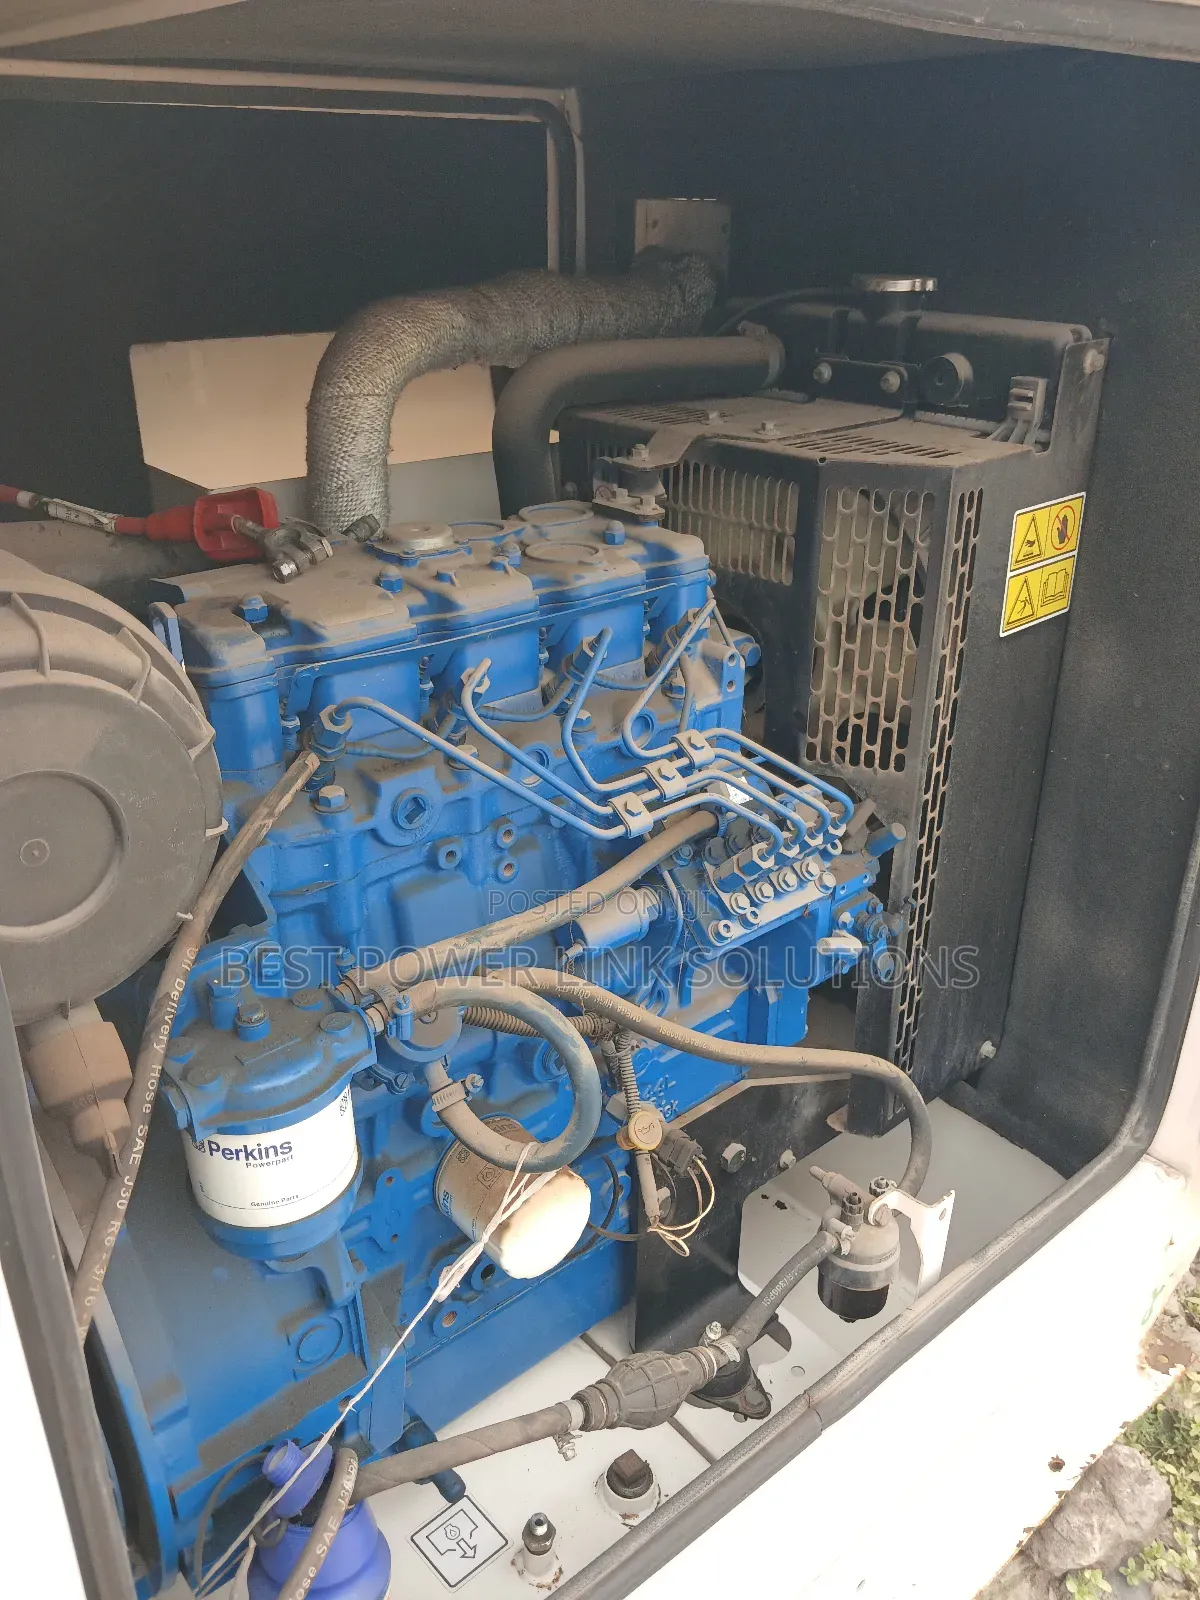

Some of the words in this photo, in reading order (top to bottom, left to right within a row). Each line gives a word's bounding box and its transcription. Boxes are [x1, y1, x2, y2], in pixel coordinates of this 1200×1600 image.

[153, 977, 186, 1054] Delivery
[616, 1005, 642, 1023] OMEGA
[142, 1064, 162, 1114] Hose
[129, 1124, 149, 1166] SAE
[207, 1140, 293, 1162] Perkins
[245, 1155, 294, 1169] Powerpart
[116, 1175, 135, 1210] J30
[288, 1566, 317, 1600] ose
[316, 1516, 340, 1557] SAE
